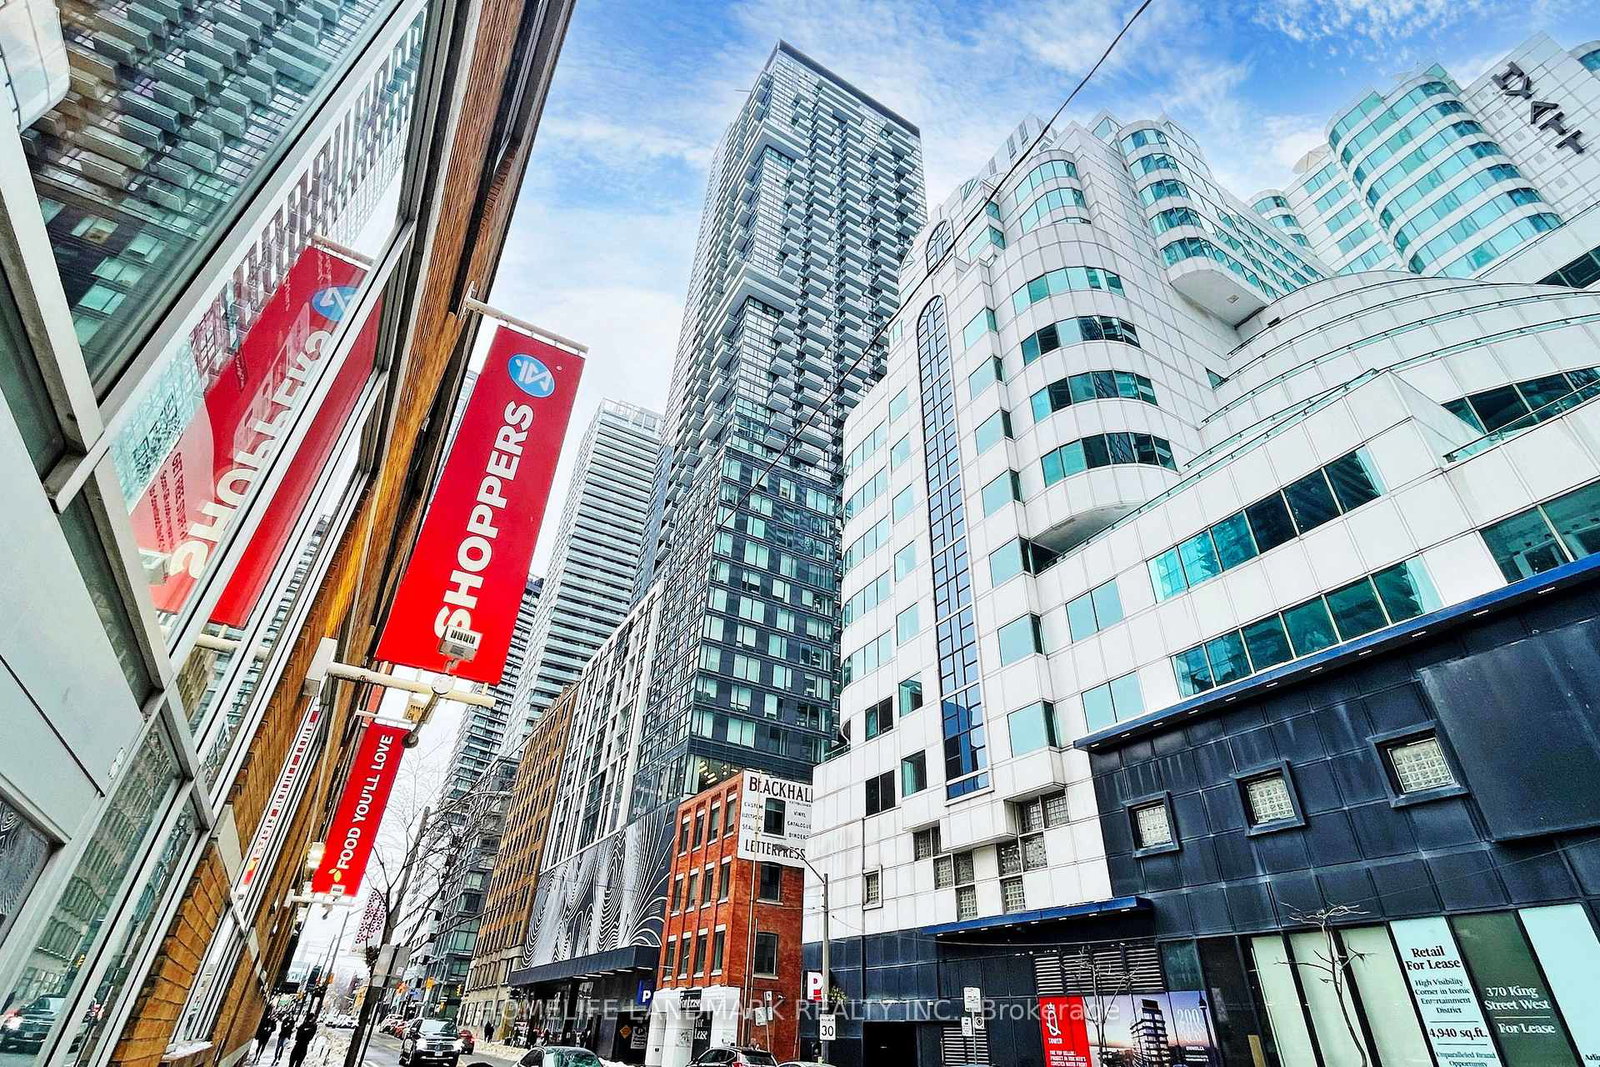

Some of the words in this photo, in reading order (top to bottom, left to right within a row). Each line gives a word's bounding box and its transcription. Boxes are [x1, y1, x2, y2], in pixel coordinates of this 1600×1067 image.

[1491, 61, 1585, 154] HYATT
[434, 400, 534, 642] SHOPPERS
[336, 827, 361, 870] FOOD
[352, 774, 380, 823] YOU'LL
[371, 735, 394, 771] LOVE
[745, 838, 806, 861] LETTERPRESS
[1411, 946, 1446, 958] Retail
[1405, 960, 1425, 971] For
[1428, 959, 1461, 970] Lease
[1415, 979, 1432, 987] High
[1433, 978, 1463, 986] Visibility
[642, 990, 652, 1003] P
[1485, 986, 1508, 997] 370
[1508, 985, 1539, 999] King
[1484, 1000, 1519, 1011] Street
[1519, 1000, 1552, 1010] West
[821, 1025, 834, 1037] 30
[1429, 1028, 1457, 1039] 4,940
[1460, 1027, 1488, 1041] sq.ft.
[1498, 1023, 1519, 1034] For
[1519, 1023, 1556, 1034] Lease
